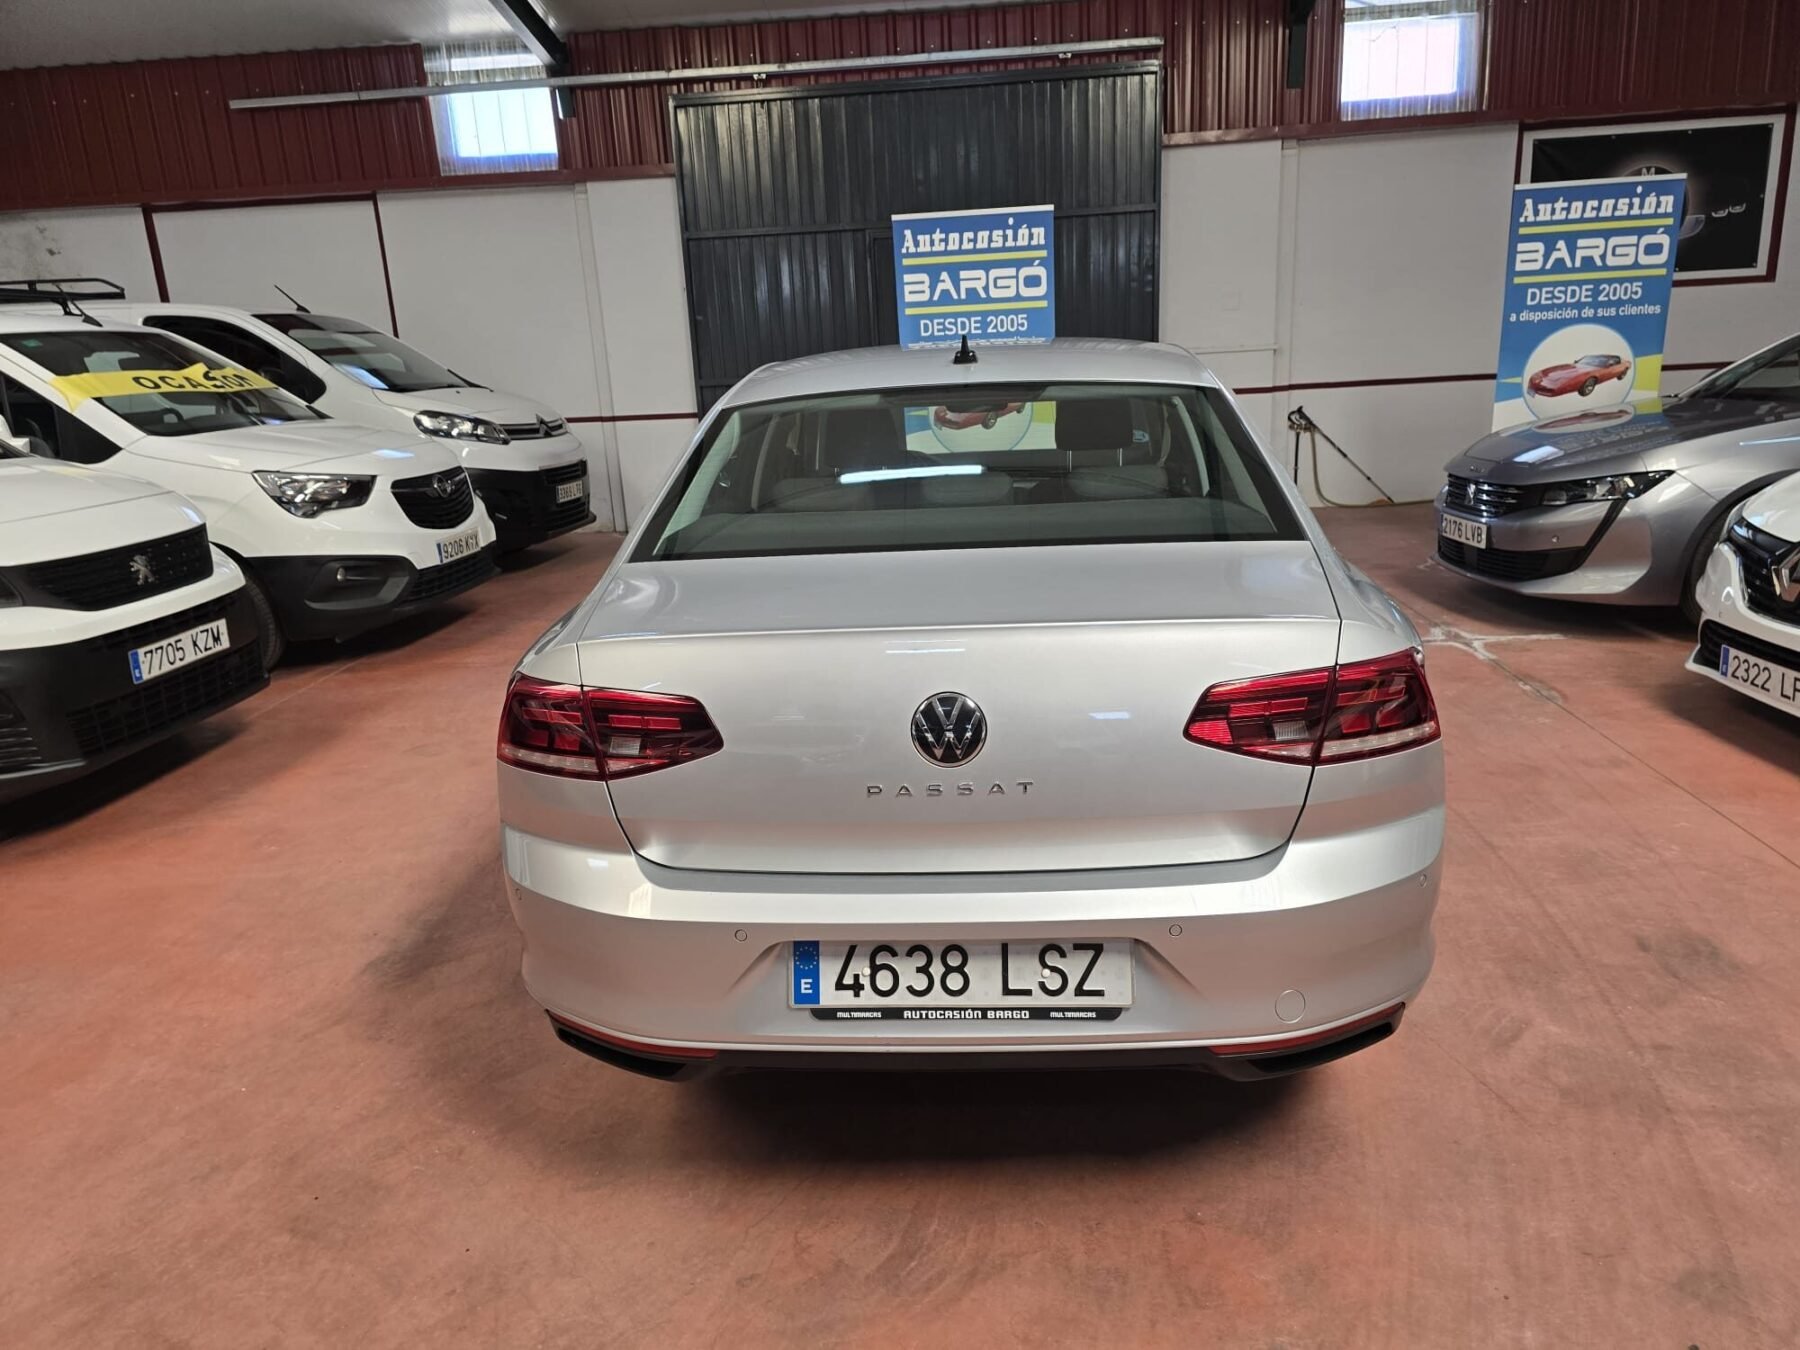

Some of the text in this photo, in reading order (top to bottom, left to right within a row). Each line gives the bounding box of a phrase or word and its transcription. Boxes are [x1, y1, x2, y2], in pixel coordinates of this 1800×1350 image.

[1519, 185, 1674, 223] Autocasión
[902, 217, 1046, 254] Autocasión
[1515, 228, 1670, 272] BARGÓ
[903, 260, 1048, 303] BARGÓ
[1526, 282, 1643, 306] DESDE 2005
[920, 314, 1028, 337] DESDE 2005
[1509, 304, 1661, 323] a disposición de sus clientes
[1443, 517, 1483, 544] 2176 LVB
[442, 538, 464, 560] 9206
[143, 639, 186, 675] 7705
[191, 624, 223, 656] KZM
[1731, 655, 1772, 693] 2322
[866, 780, 1034, 797] PASSAT
[800, 942, 1106, 998] E 4638 LSZ
[903, 1008, 982, 1019] AUTOCASIÓN
[987, 1010, 1030, 1019] BARGO
